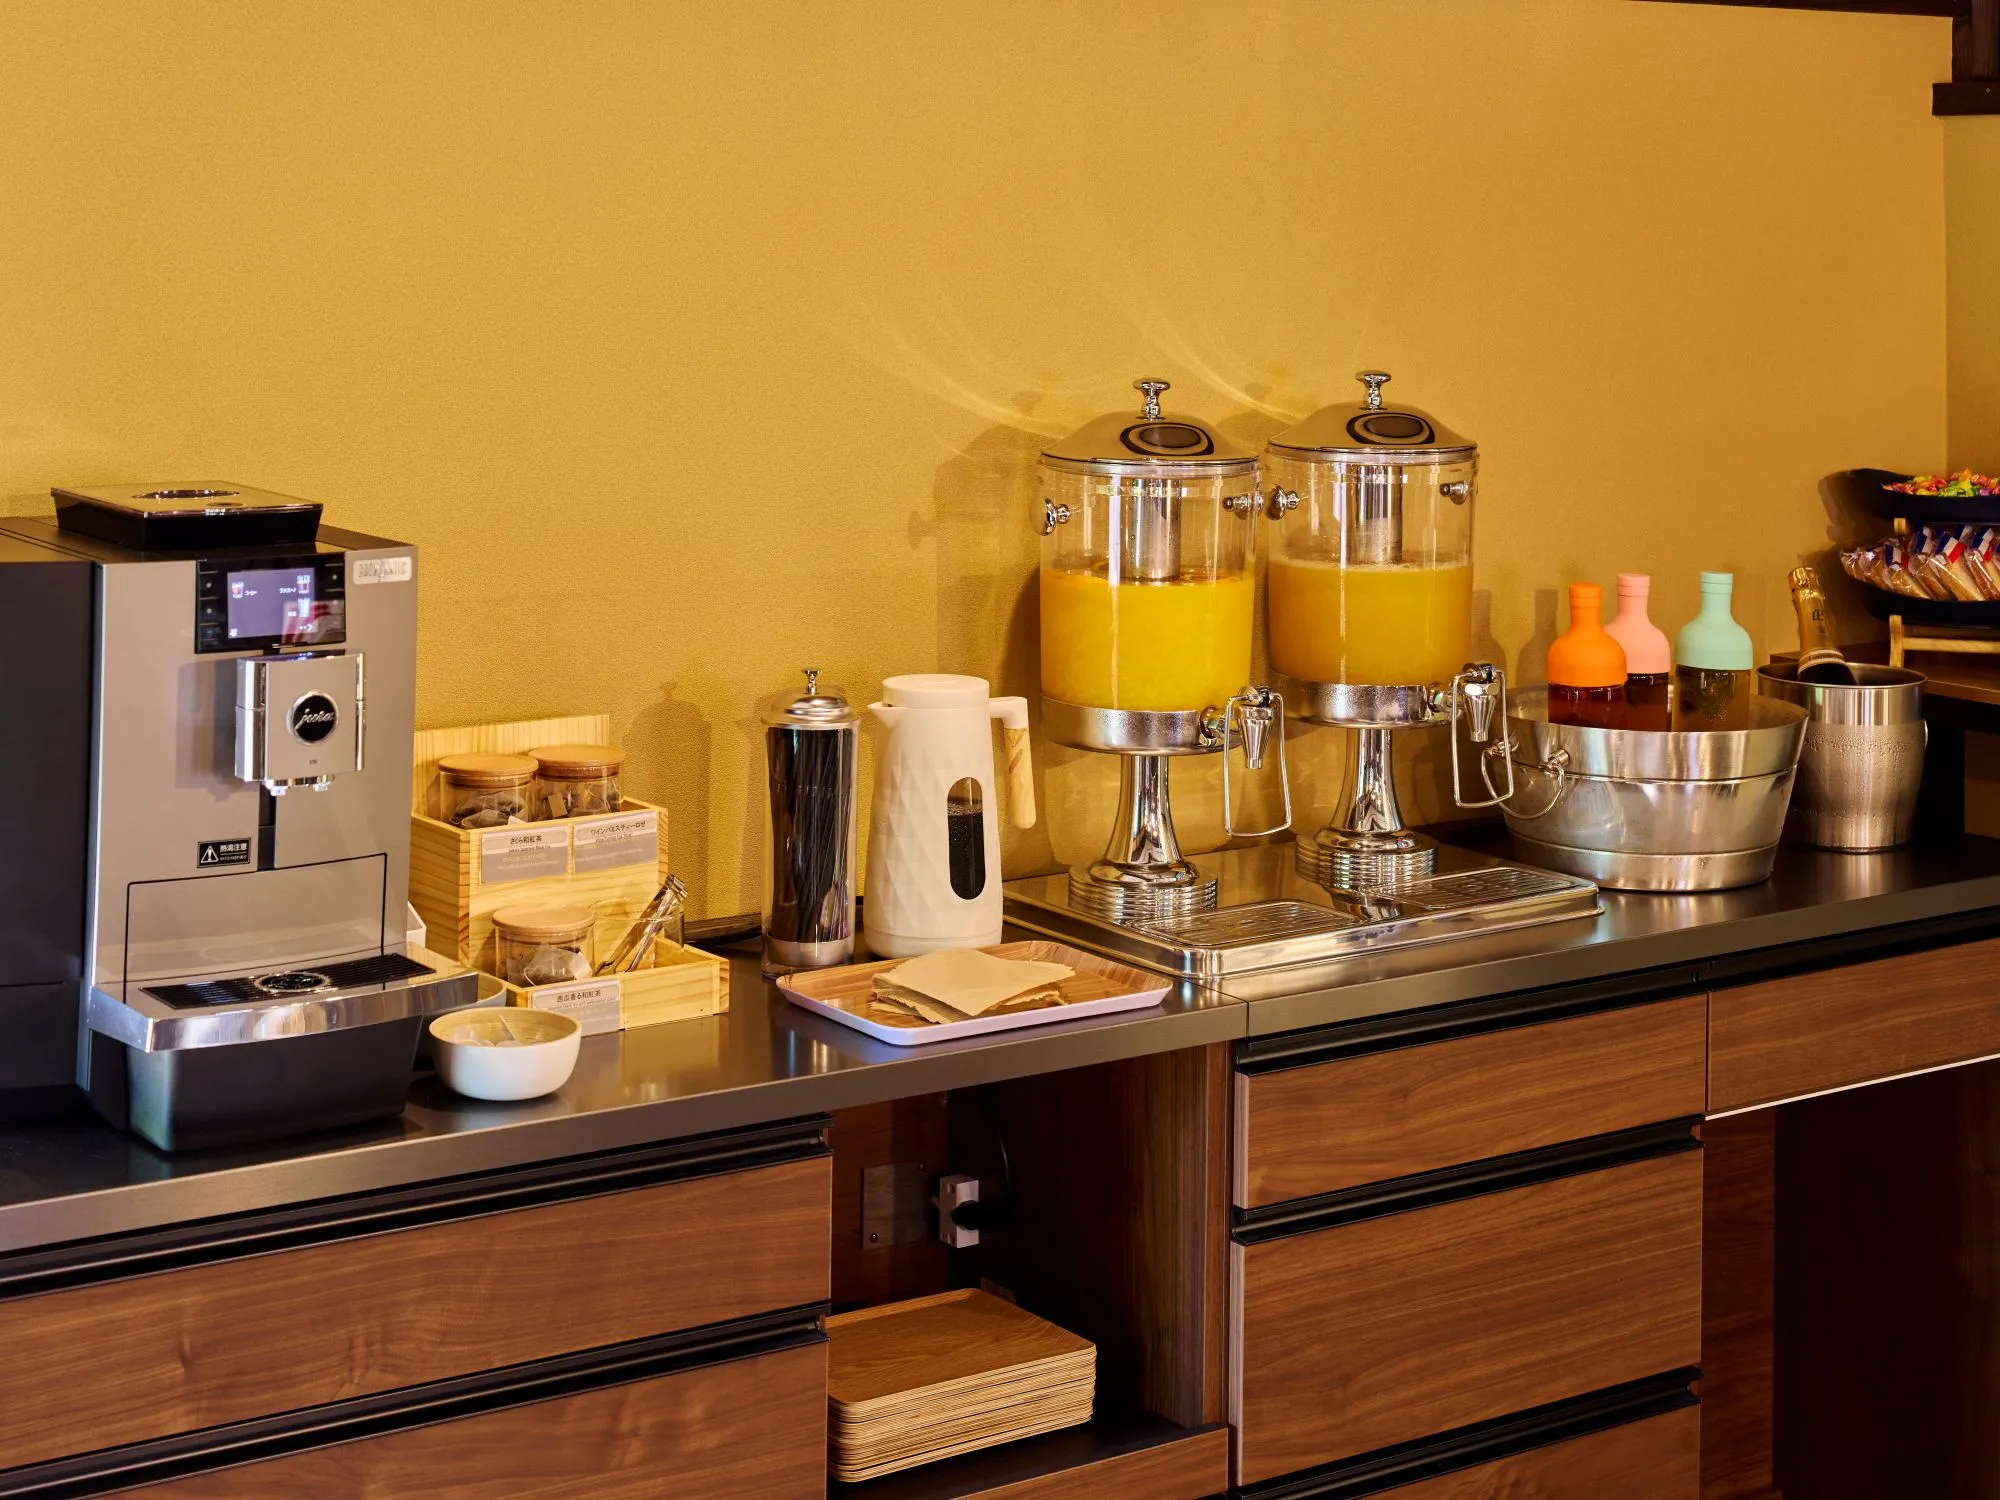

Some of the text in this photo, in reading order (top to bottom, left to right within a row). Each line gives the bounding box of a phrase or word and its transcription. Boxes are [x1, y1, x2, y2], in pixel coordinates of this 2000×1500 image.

[294, 708, 334, 731] jura
[510, 835, 542, 845] さくら和紅茶
[557, 990, 601, 1003] 西瓜香る和紅茶
